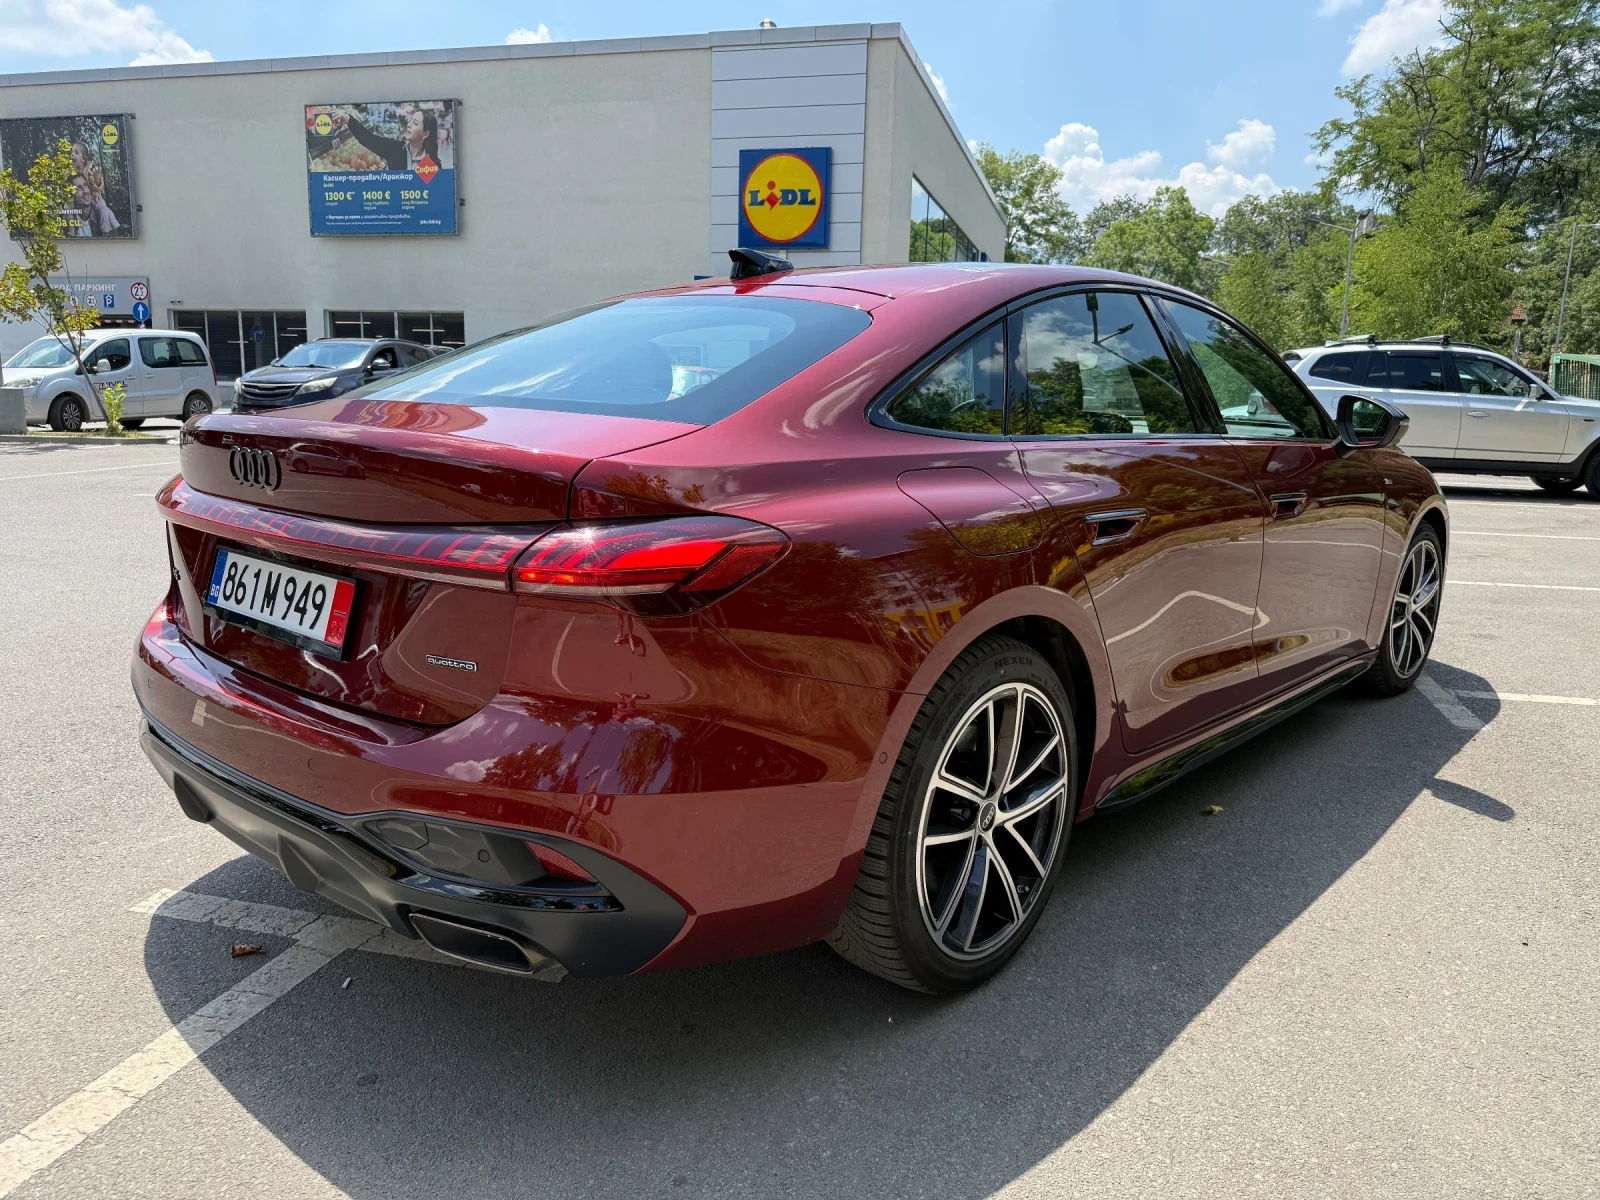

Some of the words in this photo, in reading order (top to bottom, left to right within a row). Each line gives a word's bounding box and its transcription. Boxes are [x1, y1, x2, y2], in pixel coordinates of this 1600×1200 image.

[415, 165, 438, 174] София
[324, 192, 344, 200] 1300
[362, 191, 383, 200] 1400
[385, 191, 391, 199] €
[400, 190, 421, 199] 1500
[423, 190, 429, 199] €
[749, 181, 816, 210] LIDL
[74, 284, 117, 292] ПАРКИНГ
[210, 583, 220, 597] BG
[427, 656, 475, 671] quattro
[994, 656, 1033, 669] NEXEN
